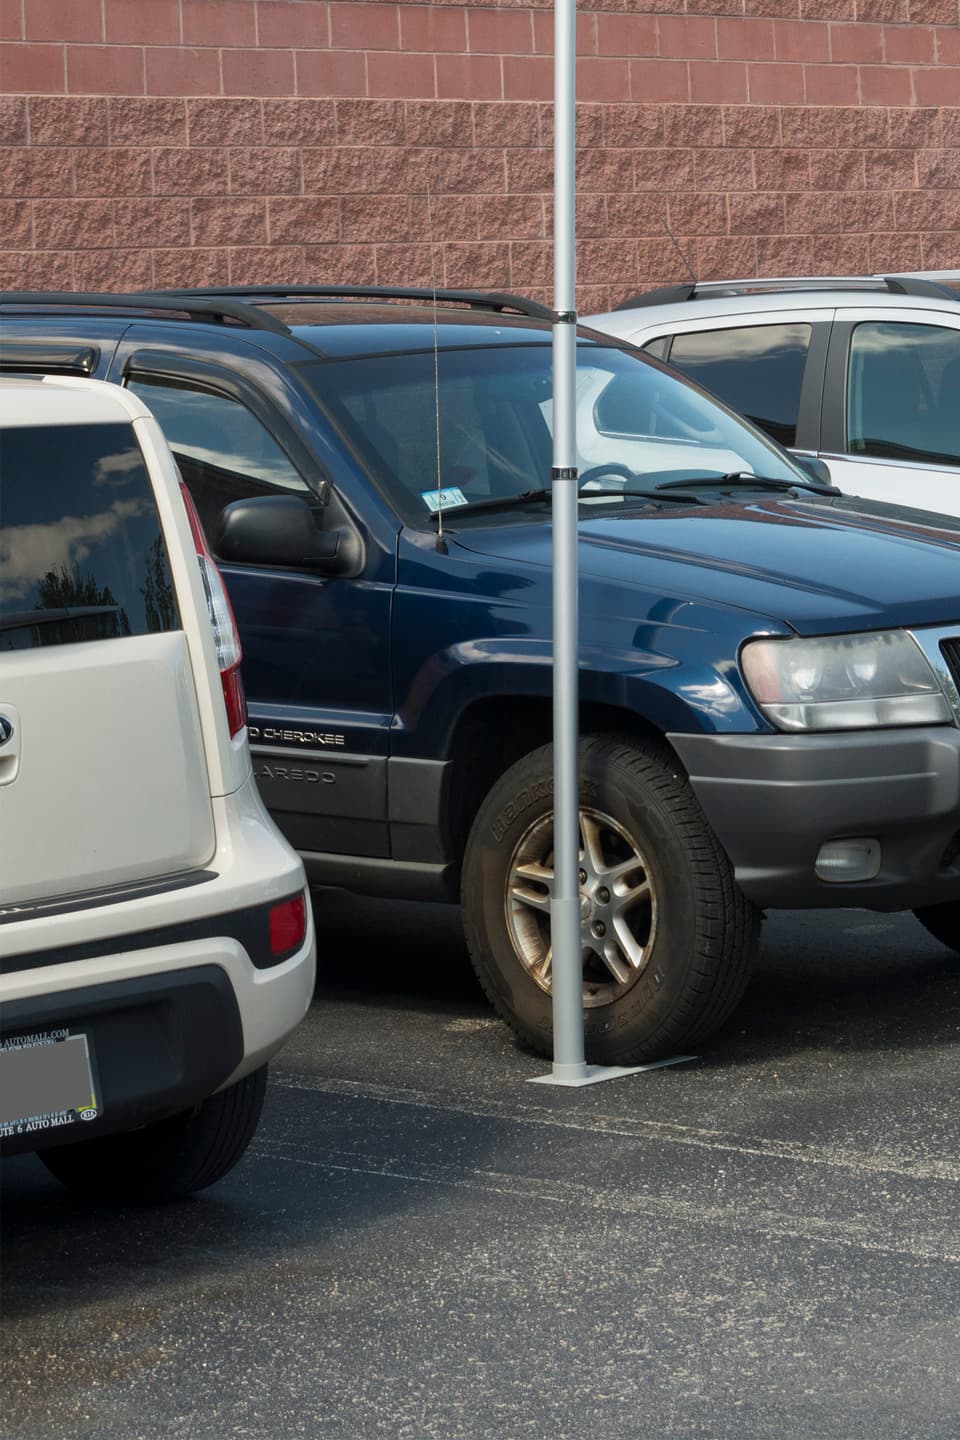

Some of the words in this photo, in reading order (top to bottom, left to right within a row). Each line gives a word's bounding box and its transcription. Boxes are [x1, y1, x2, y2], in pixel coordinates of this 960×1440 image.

[263, 728, 345, 745] CHEROKEE
[254, 765, 337, 783] AREDO
[82, 1109, 95, 1119] KIA
[17, 1124, 23, 1134] 6
[26, 1119, 50, 1132] AUTO
[51, 1114, 75, 1127] MALL
